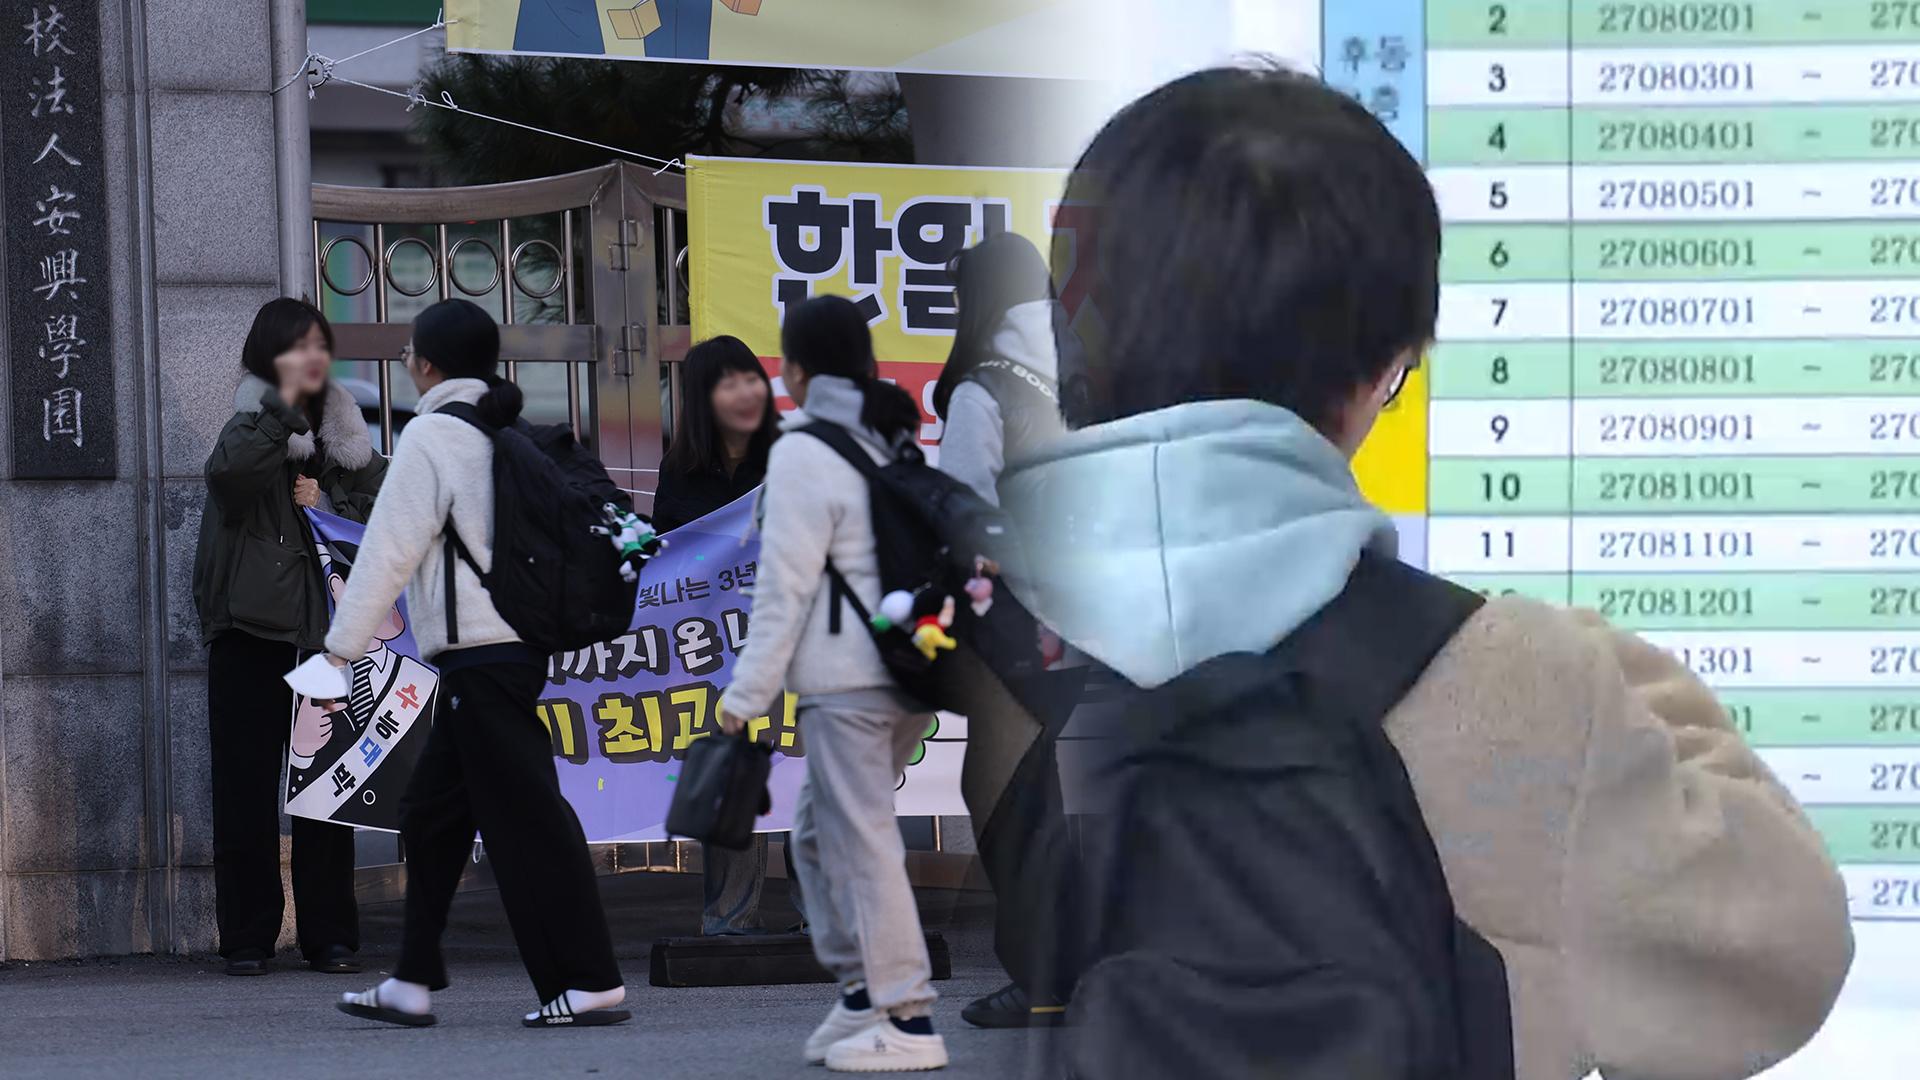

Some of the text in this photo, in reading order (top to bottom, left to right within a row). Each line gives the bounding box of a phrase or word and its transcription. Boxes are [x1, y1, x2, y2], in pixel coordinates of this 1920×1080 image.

[1489, 5, 1507, 33] 2
[1600, 5, 1753, 32] 27080201
[1488, 64, 1506, 92] 3
[1600, 63, 1753, 90] 27080301
[1488, 123, 1507, 151] 4
[1600, 122, 1753, 149] 27080401
[1490, 182, 1508, 209] 5
[1600, 181, 1753, 208] 27080501
[1490, 241, 1509, 268] 6
[1600, 240, 1753, 267] 27080601
[1491, 299, 1508, 326] 7
[1600, 298, 1753, 325] 27080701
[1491, 357, 1509, 384] 8
[1600, 356, 1753, 383] 27080801
[1490, 415, 1509, 442] 9
[1600, 415, 1753, 442] 27080901
[1482, 473, 1521, 500] 10
[1600, 473, 1753, 500] 27081001
[1481, 532, 1514, 558] 11
[1600, 531, 1753, 558] 27081101
[638, 576, 711, 610] 빛나는
[1600, 590, 1753, 617] 27081201
[547, 627, 659, 680] 까지
[675, 618, 714, 671] 온
[546, 1016, 574, 1024] adidas
